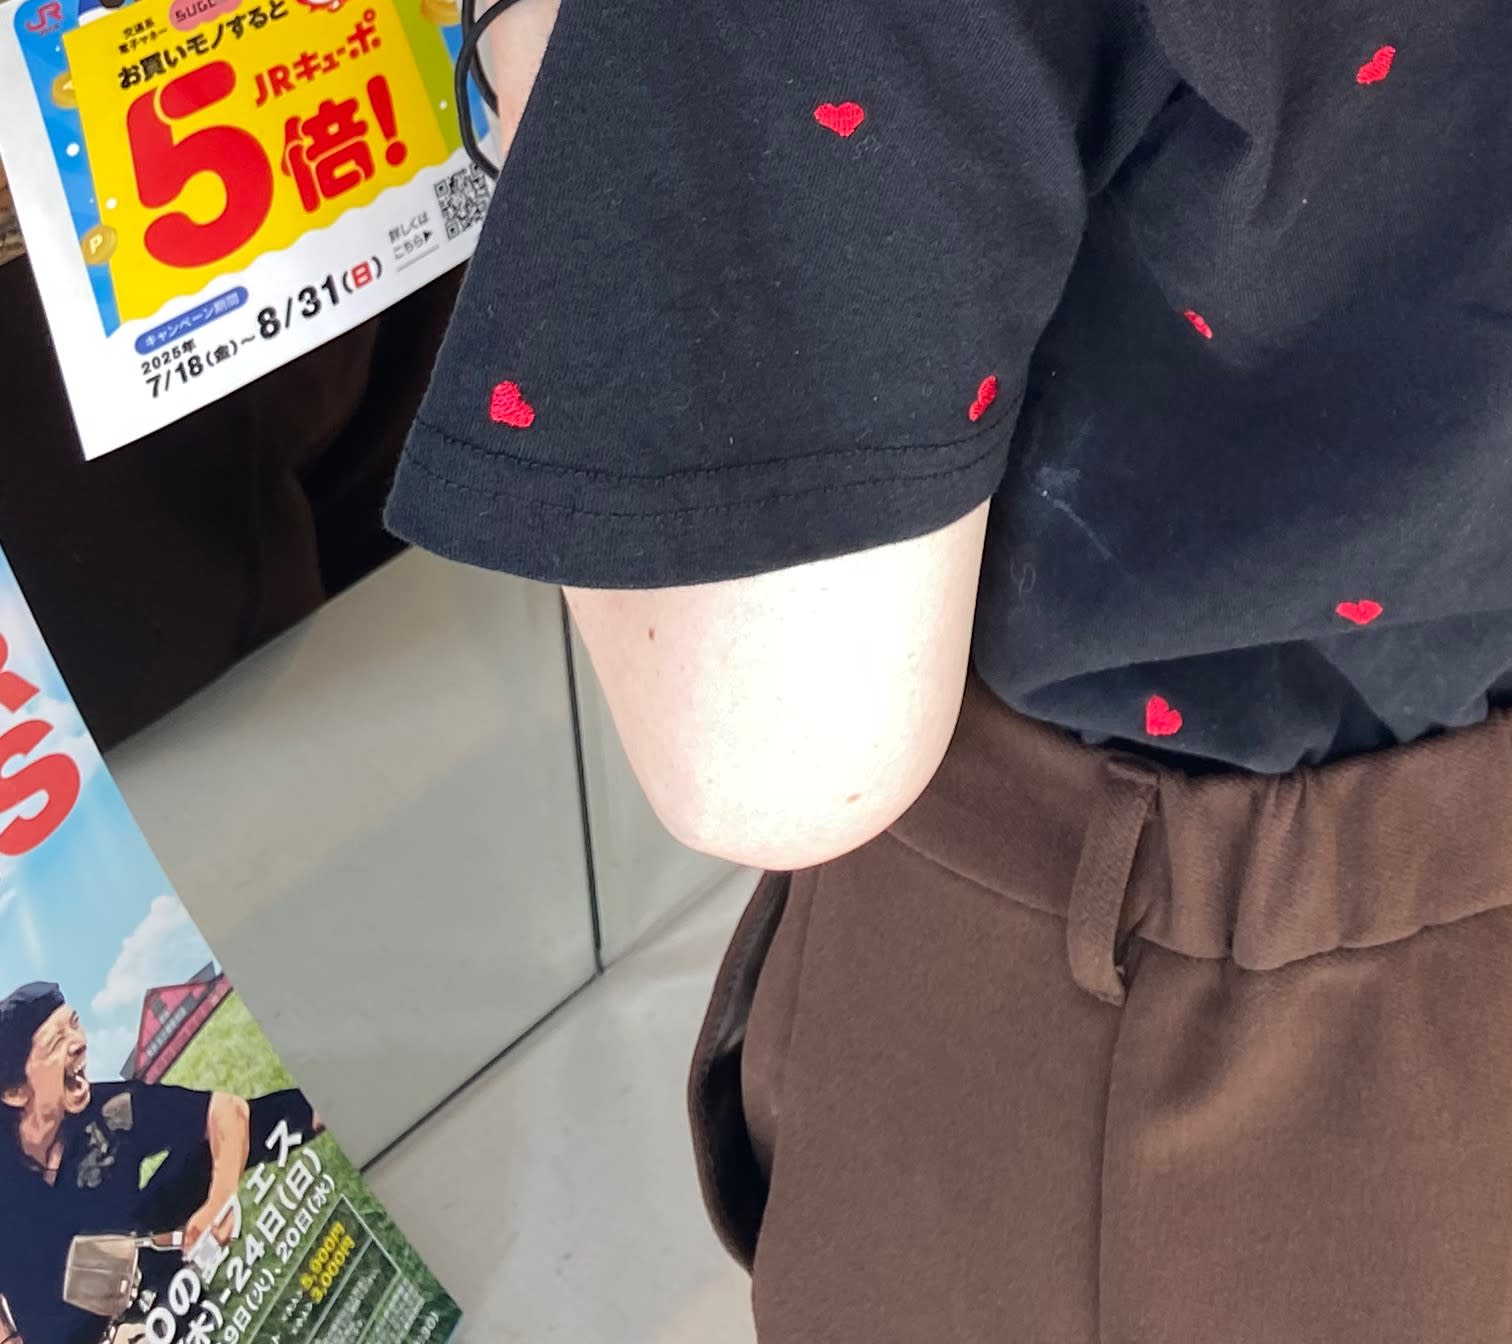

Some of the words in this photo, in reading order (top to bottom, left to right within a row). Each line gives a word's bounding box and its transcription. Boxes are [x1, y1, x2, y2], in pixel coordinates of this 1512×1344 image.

[25, 0, 63, 32] JR
[117, 0, 289, 90] お買いモノすると
[255, 9, 382, 107] JRキューポ
[146, 292, 241, 347] キャンペーン期間
[141, 338, 197, 376] 2025年
